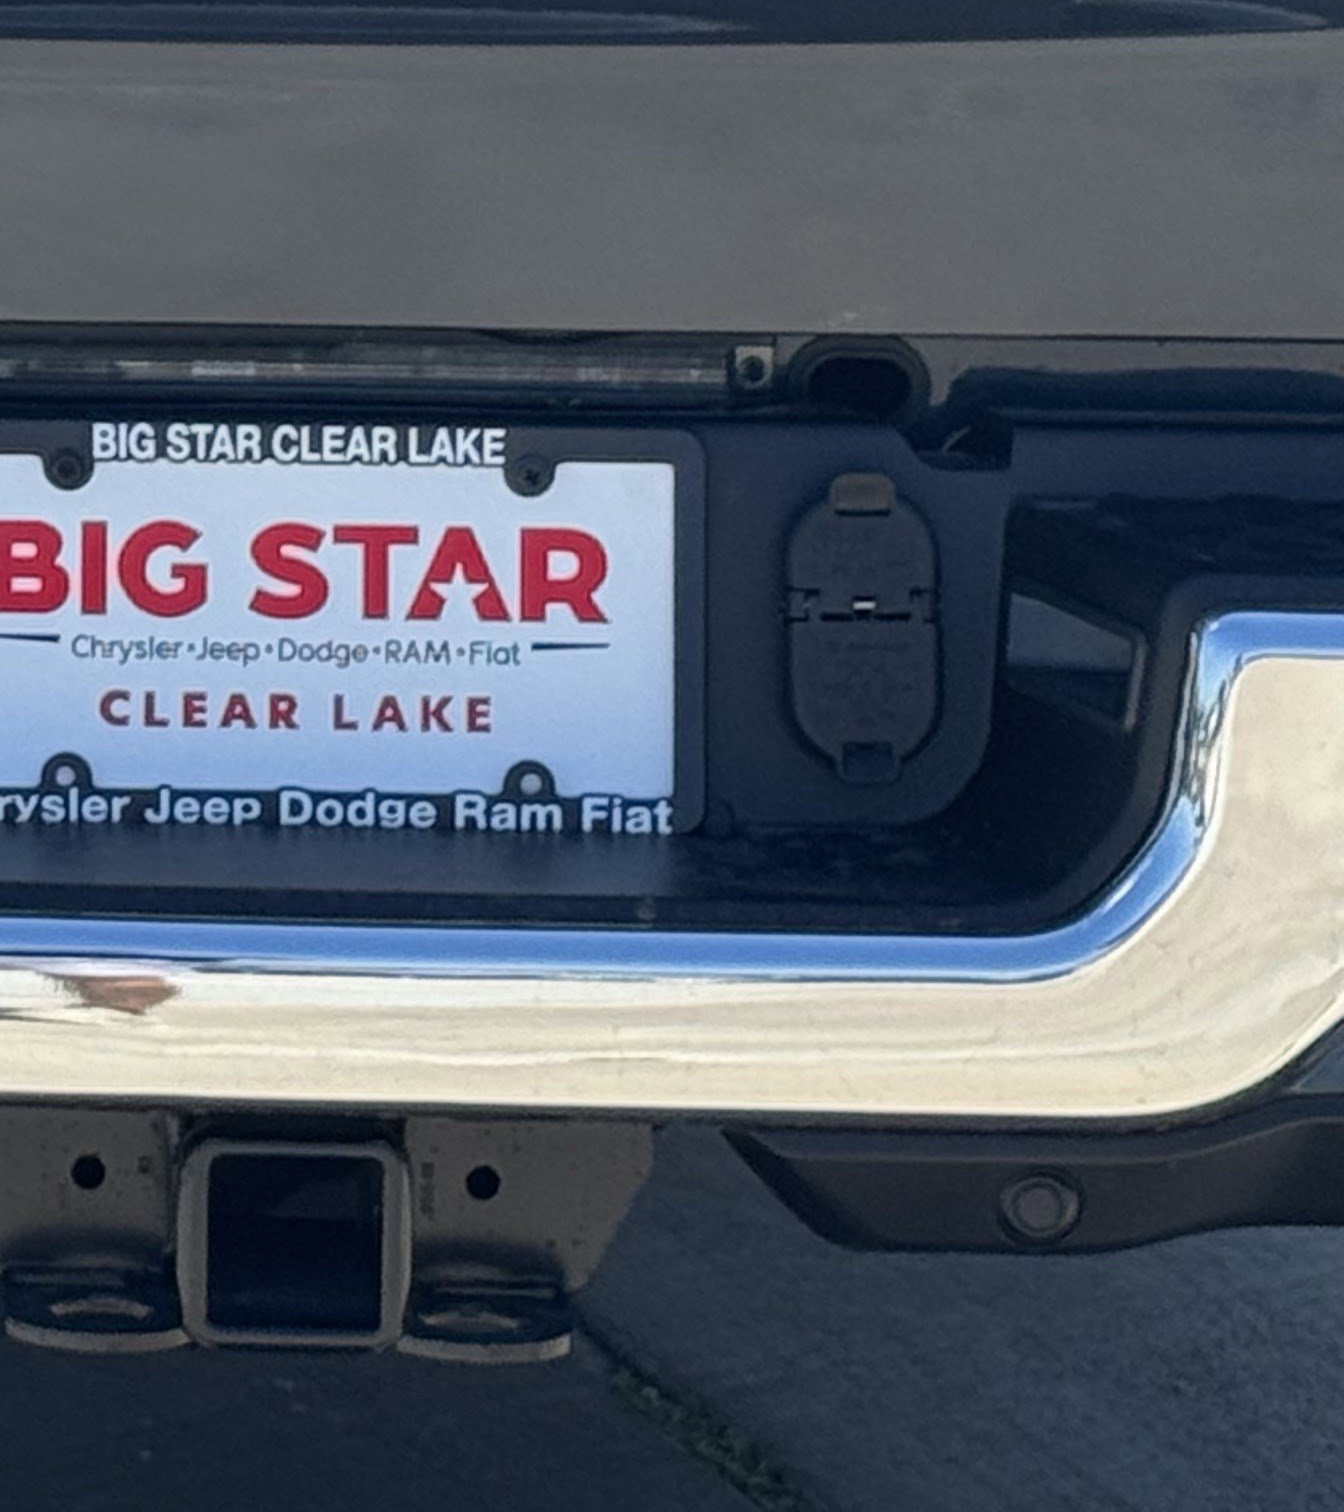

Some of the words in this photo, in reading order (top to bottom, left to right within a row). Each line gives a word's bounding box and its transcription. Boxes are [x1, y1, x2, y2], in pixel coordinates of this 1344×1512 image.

[92, 422, 156, 461] BIG
[166, 423, 261, 462] STAR
[272, 425, 402, 464] CLEAR
[409, 427, 506, 466] LAKE
[249, 521, 609, 623] STAR
[99, 689, 300, 730] CLEAR
[332, 693, 492, 734] LAKE
[144, 788, 262, 825] Jeep
[278, 790, 437, 830] Dodge
[454, 793, 563, 832] Ram
[580, 796, 673, 835] Fiat
